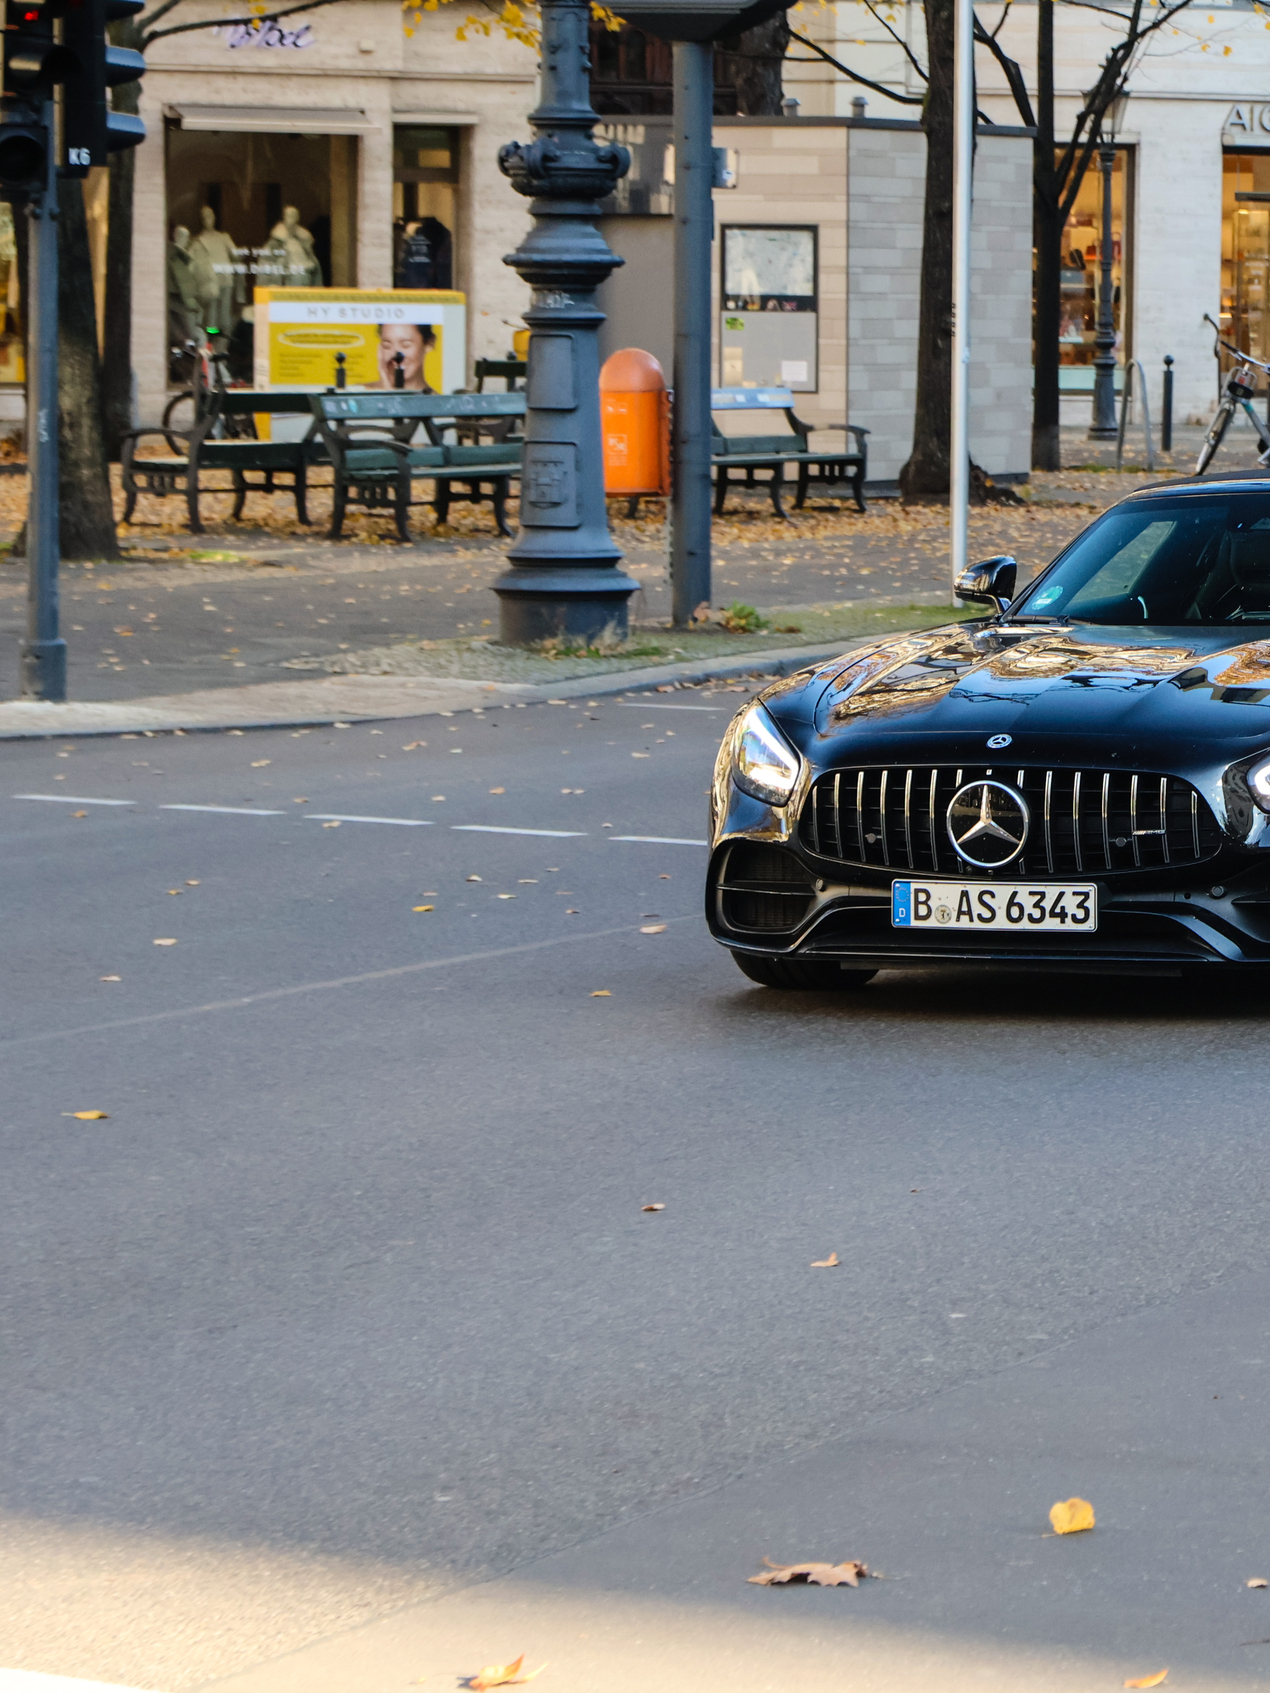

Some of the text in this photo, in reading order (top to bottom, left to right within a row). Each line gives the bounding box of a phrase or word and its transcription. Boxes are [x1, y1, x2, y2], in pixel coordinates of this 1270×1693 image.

[69, 147, 91, 165] K6
[339, 307, 405, 319] STUDIO
[898, 907, 906, 918] D
[913, 888, 1091, 924] B AS 6343
